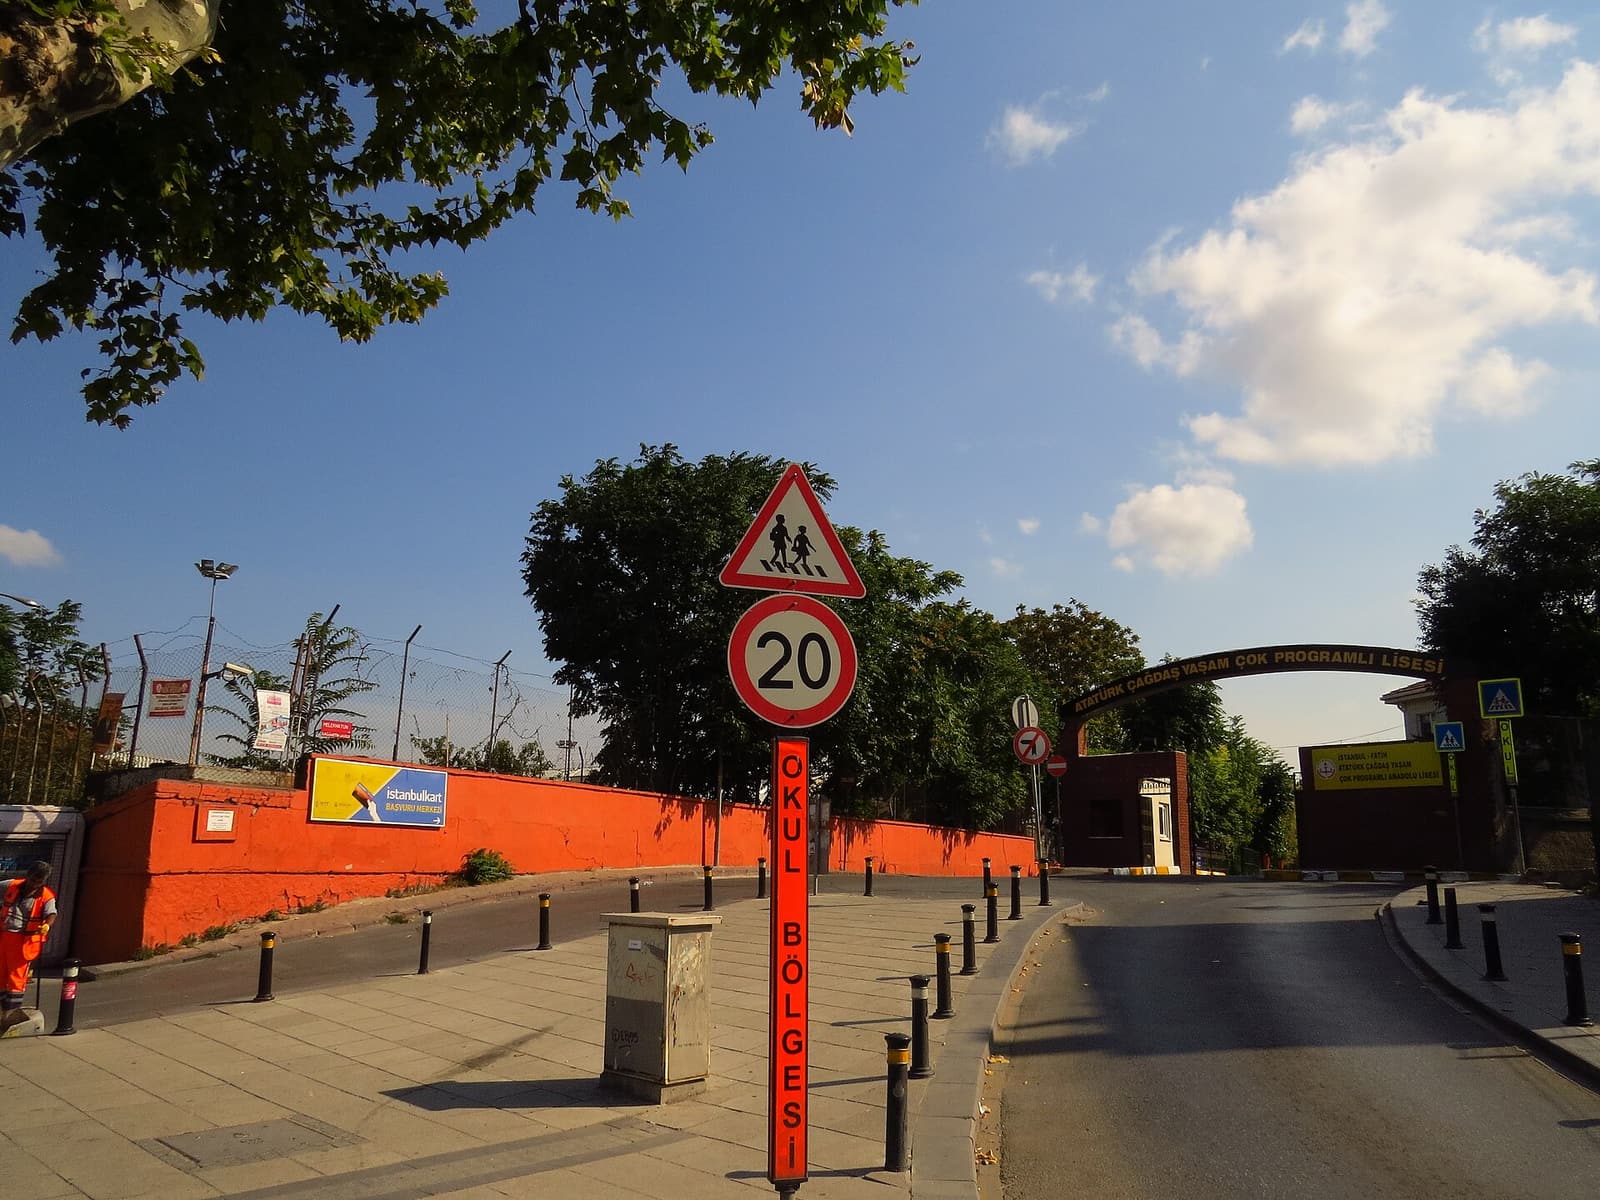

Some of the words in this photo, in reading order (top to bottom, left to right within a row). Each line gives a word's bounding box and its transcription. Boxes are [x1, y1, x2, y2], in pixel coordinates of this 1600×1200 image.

[757, 631, 831, 690] 20
[1074, 683, 1125, 713] ATATÜRK
[1127, 667, 1181, 693] ÇAĞDAŞ
[1181, 657, 1229, 675] YAŞAM
[1235, 652, 1268, 670] ÇOK
[1274, 650, 1374, 665] PROGRAMLI
[1381, 652, 1445, 674] LİSESİ
[1501, 723, 1513, 775] OKUL
[386, 786, 442, 803] istanbulkart
[782, 755, 802, 873] OKUL
[781, 922, 803, 1169] BÖLGESİ
